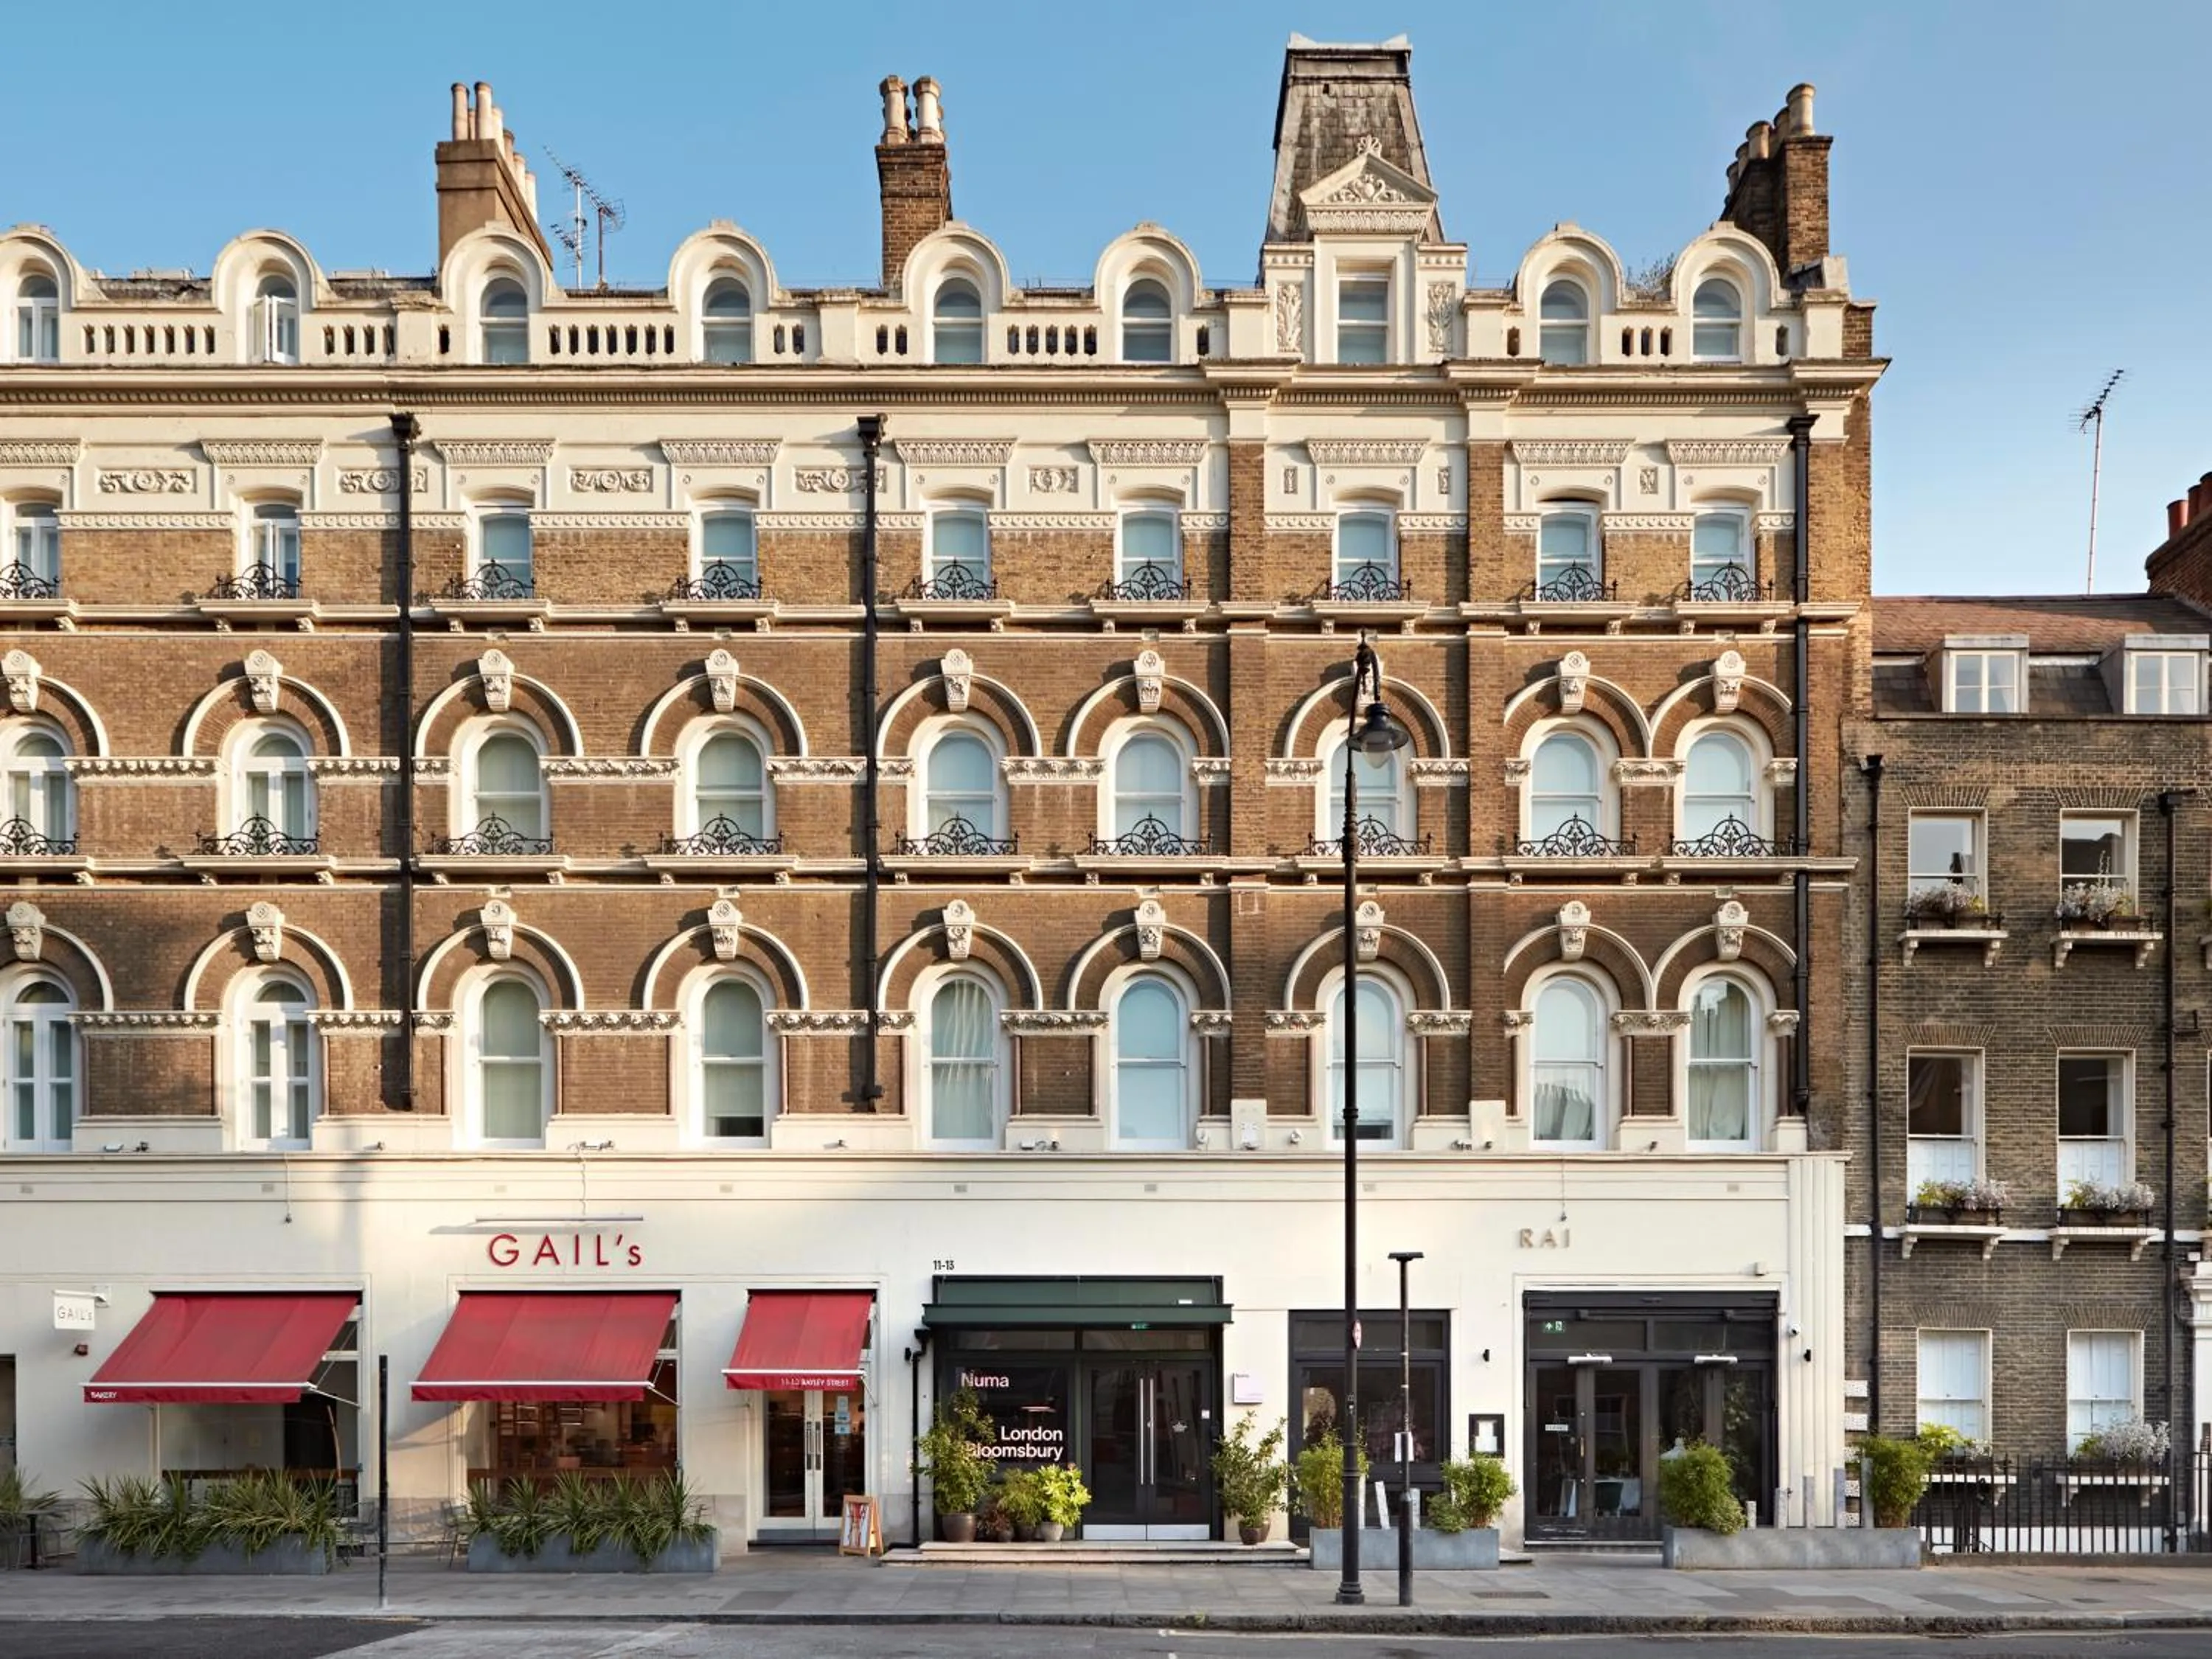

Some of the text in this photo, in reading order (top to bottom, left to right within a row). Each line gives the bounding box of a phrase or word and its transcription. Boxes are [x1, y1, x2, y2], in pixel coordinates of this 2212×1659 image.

[488, 1233, 641, 1267] GAIL's
[933, 1259, 955, 1270] 11-13
[961, 1372, 1009, 1388] Numa
[1001, 1425, 1062, 1441] London
